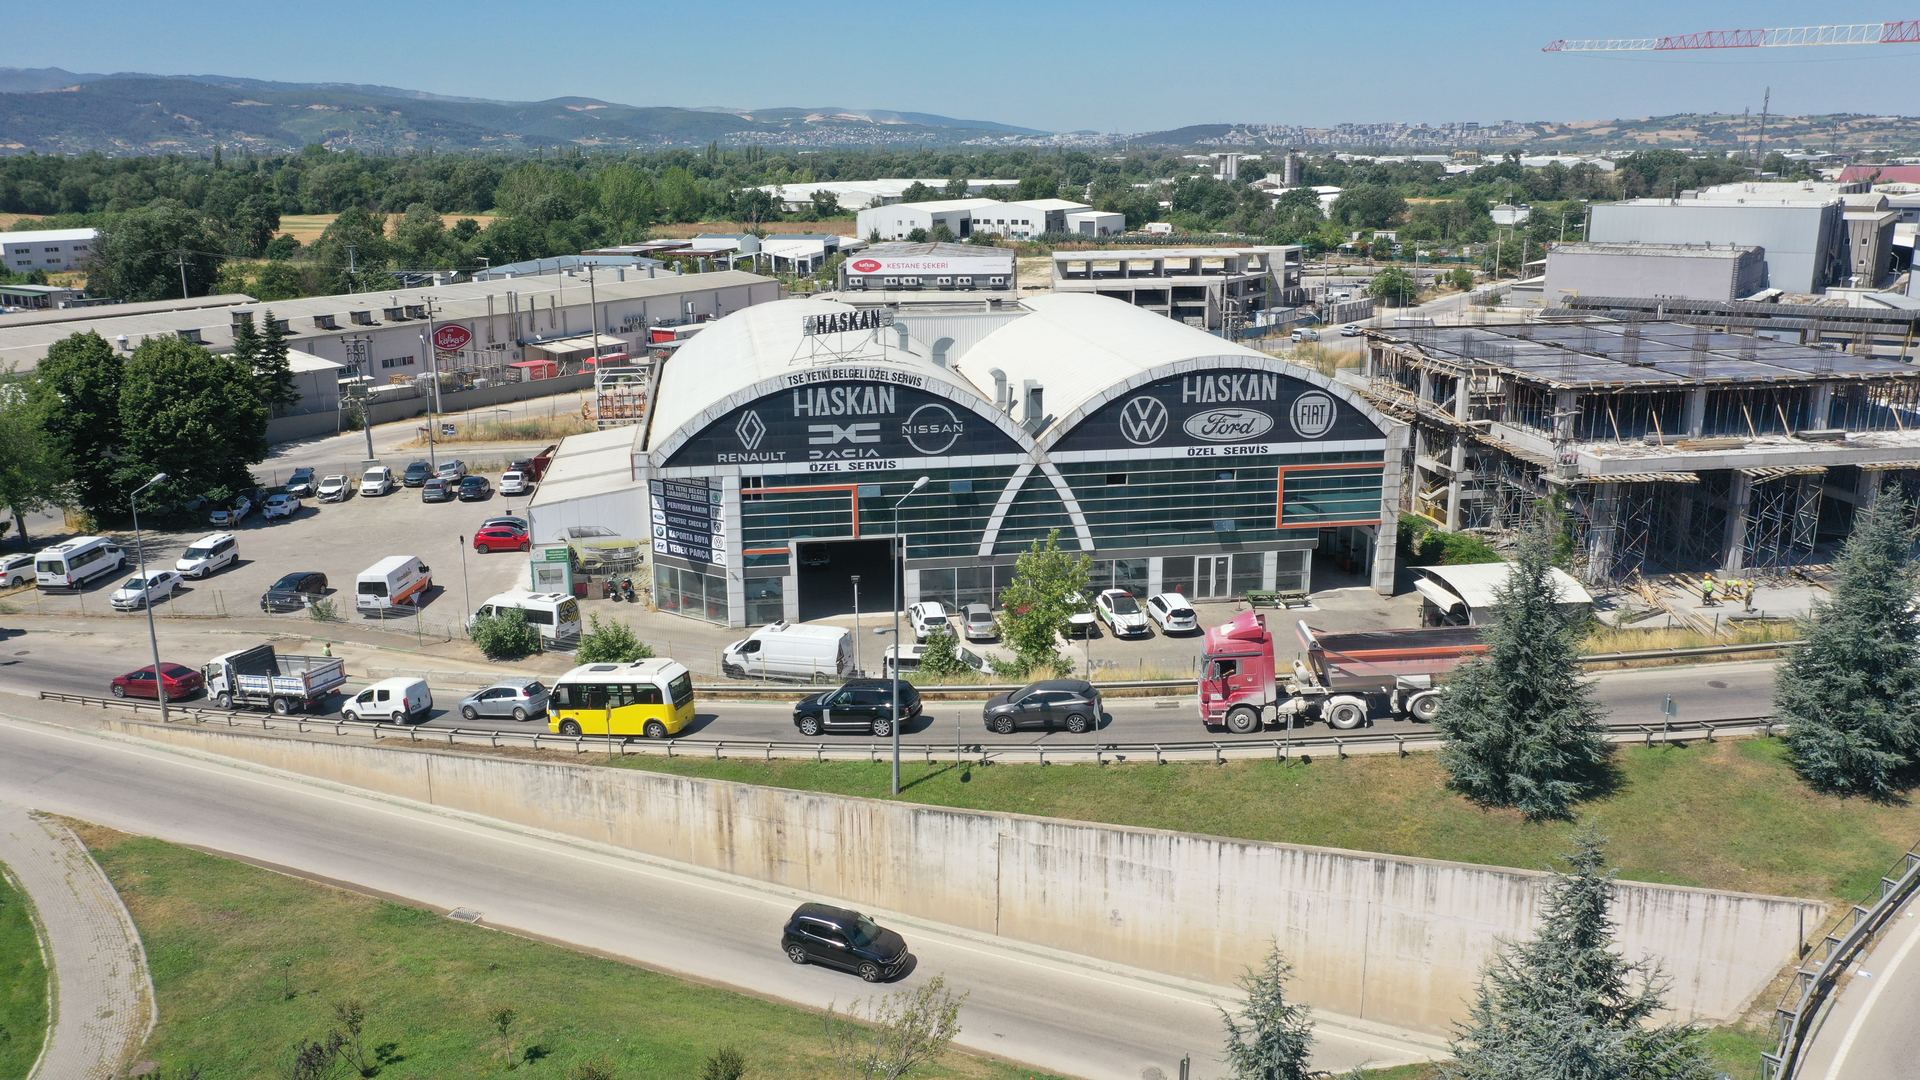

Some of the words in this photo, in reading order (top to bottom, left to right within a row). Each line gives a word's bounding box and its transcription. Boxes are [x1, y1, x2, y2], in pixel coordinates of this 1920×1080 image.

[922, 261, 948, 270] ŞEKERİ
[817, 309, 879, 334] HASKAN
[788, 373, 804, 385] TSE
[806, 367, 831, 381] YETKİ
[832, 368, 867, 379] BELGELİ
[869, 366, 889, 381] ÖZEL
[891, 372, 922, 387] SERVİS
[1182, 373, 1277, 403] HASKAN
[793, 385, 895, 417] HASKAN
[1301, 404, 1326, 425] FIAT
[902, 422, 964, 435] NISSAN
[1201, 412, 1256, 435] Ford
[717, 450, 786, 463] RENAULT
[809, 448, 880, 460] DACIA
[1187, 446, 1217, 457] ÖZEL
[1223, 445, 1269, 455] SERVİS
[809, 461, 841, 472] ÖZEL
[848, 460, 897, 471] SERVİS
[668, 530, 693, 541] KAPORTA
[694, 535, 709, 545] BOYA
[669, 543, 688, 555] YEDEK
[689, 548, 710, 560] PARÇA
